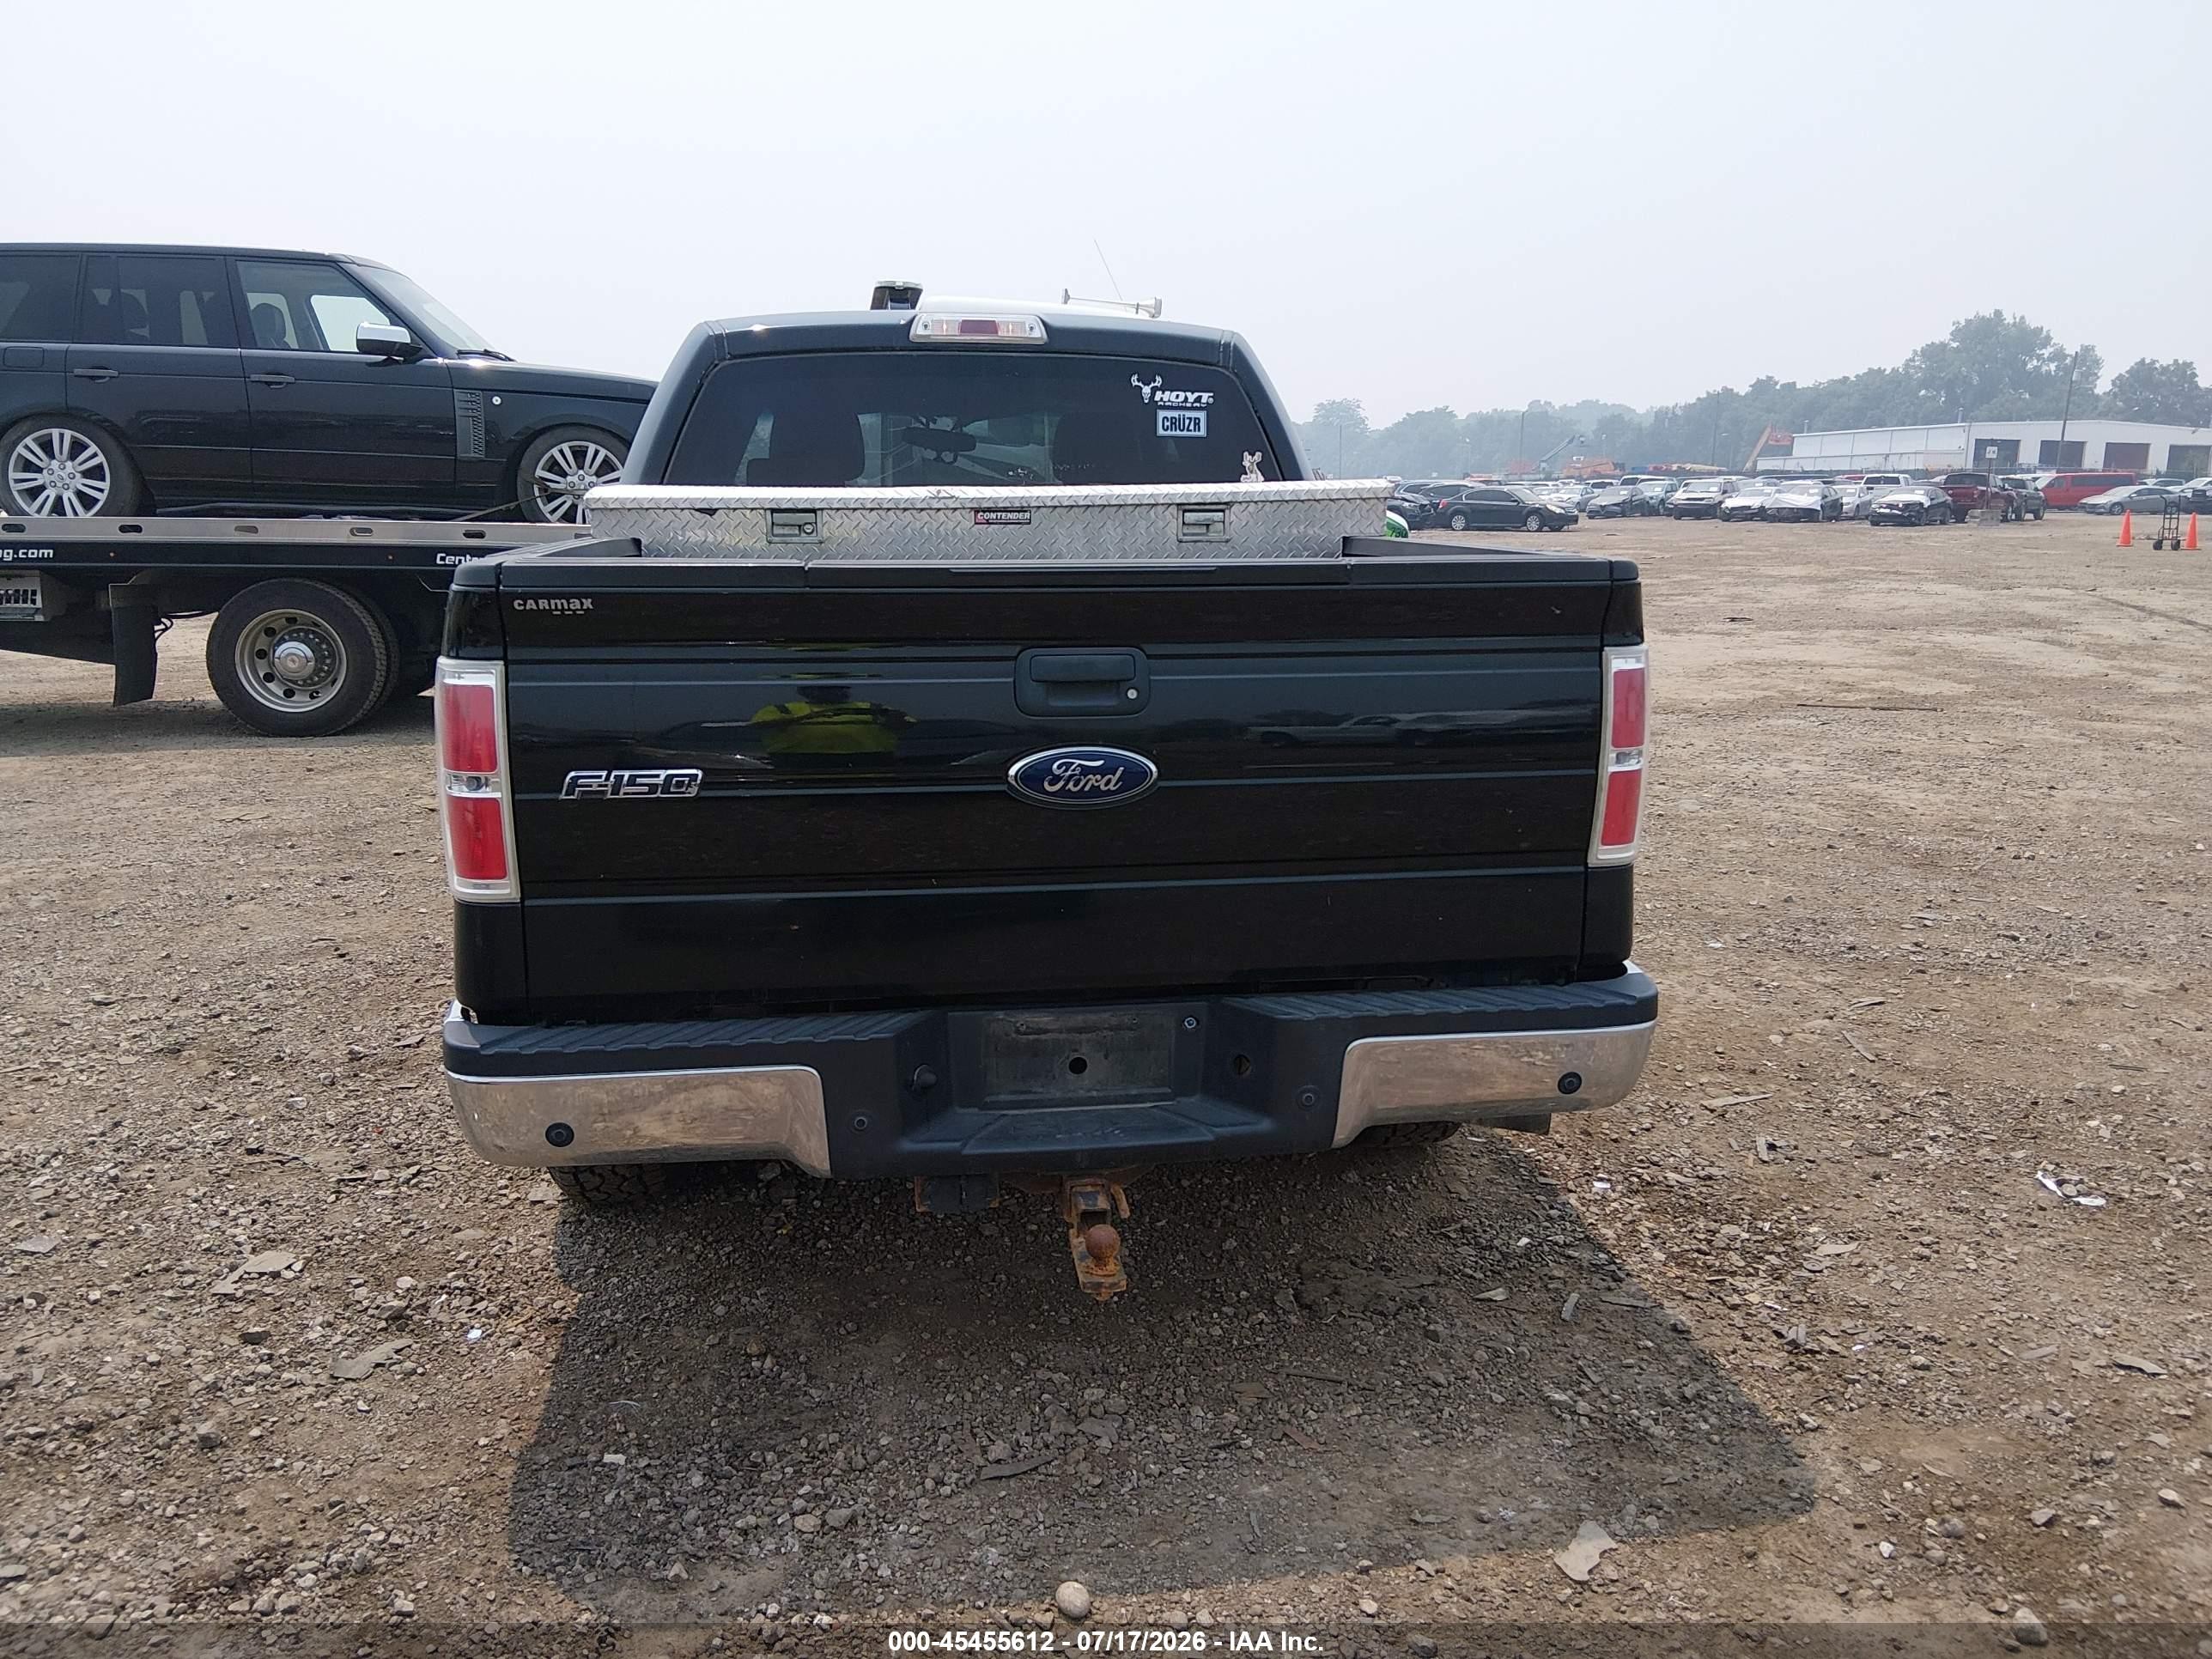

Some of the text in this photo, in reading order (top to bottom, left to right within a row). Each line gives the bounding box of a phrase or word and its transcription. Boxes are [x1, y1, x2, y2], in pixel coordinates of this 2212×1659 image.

[1153, 391, 1213, 404] HOYT
[1161, 413, 1201, 433] CRÜZR
[977, 512, 1031, 520] CONTENDER
[0, 549, 54, 562] g.com
[1043, 758, 1125, 793] Ford
[559, 769, 703, 799] F-150
